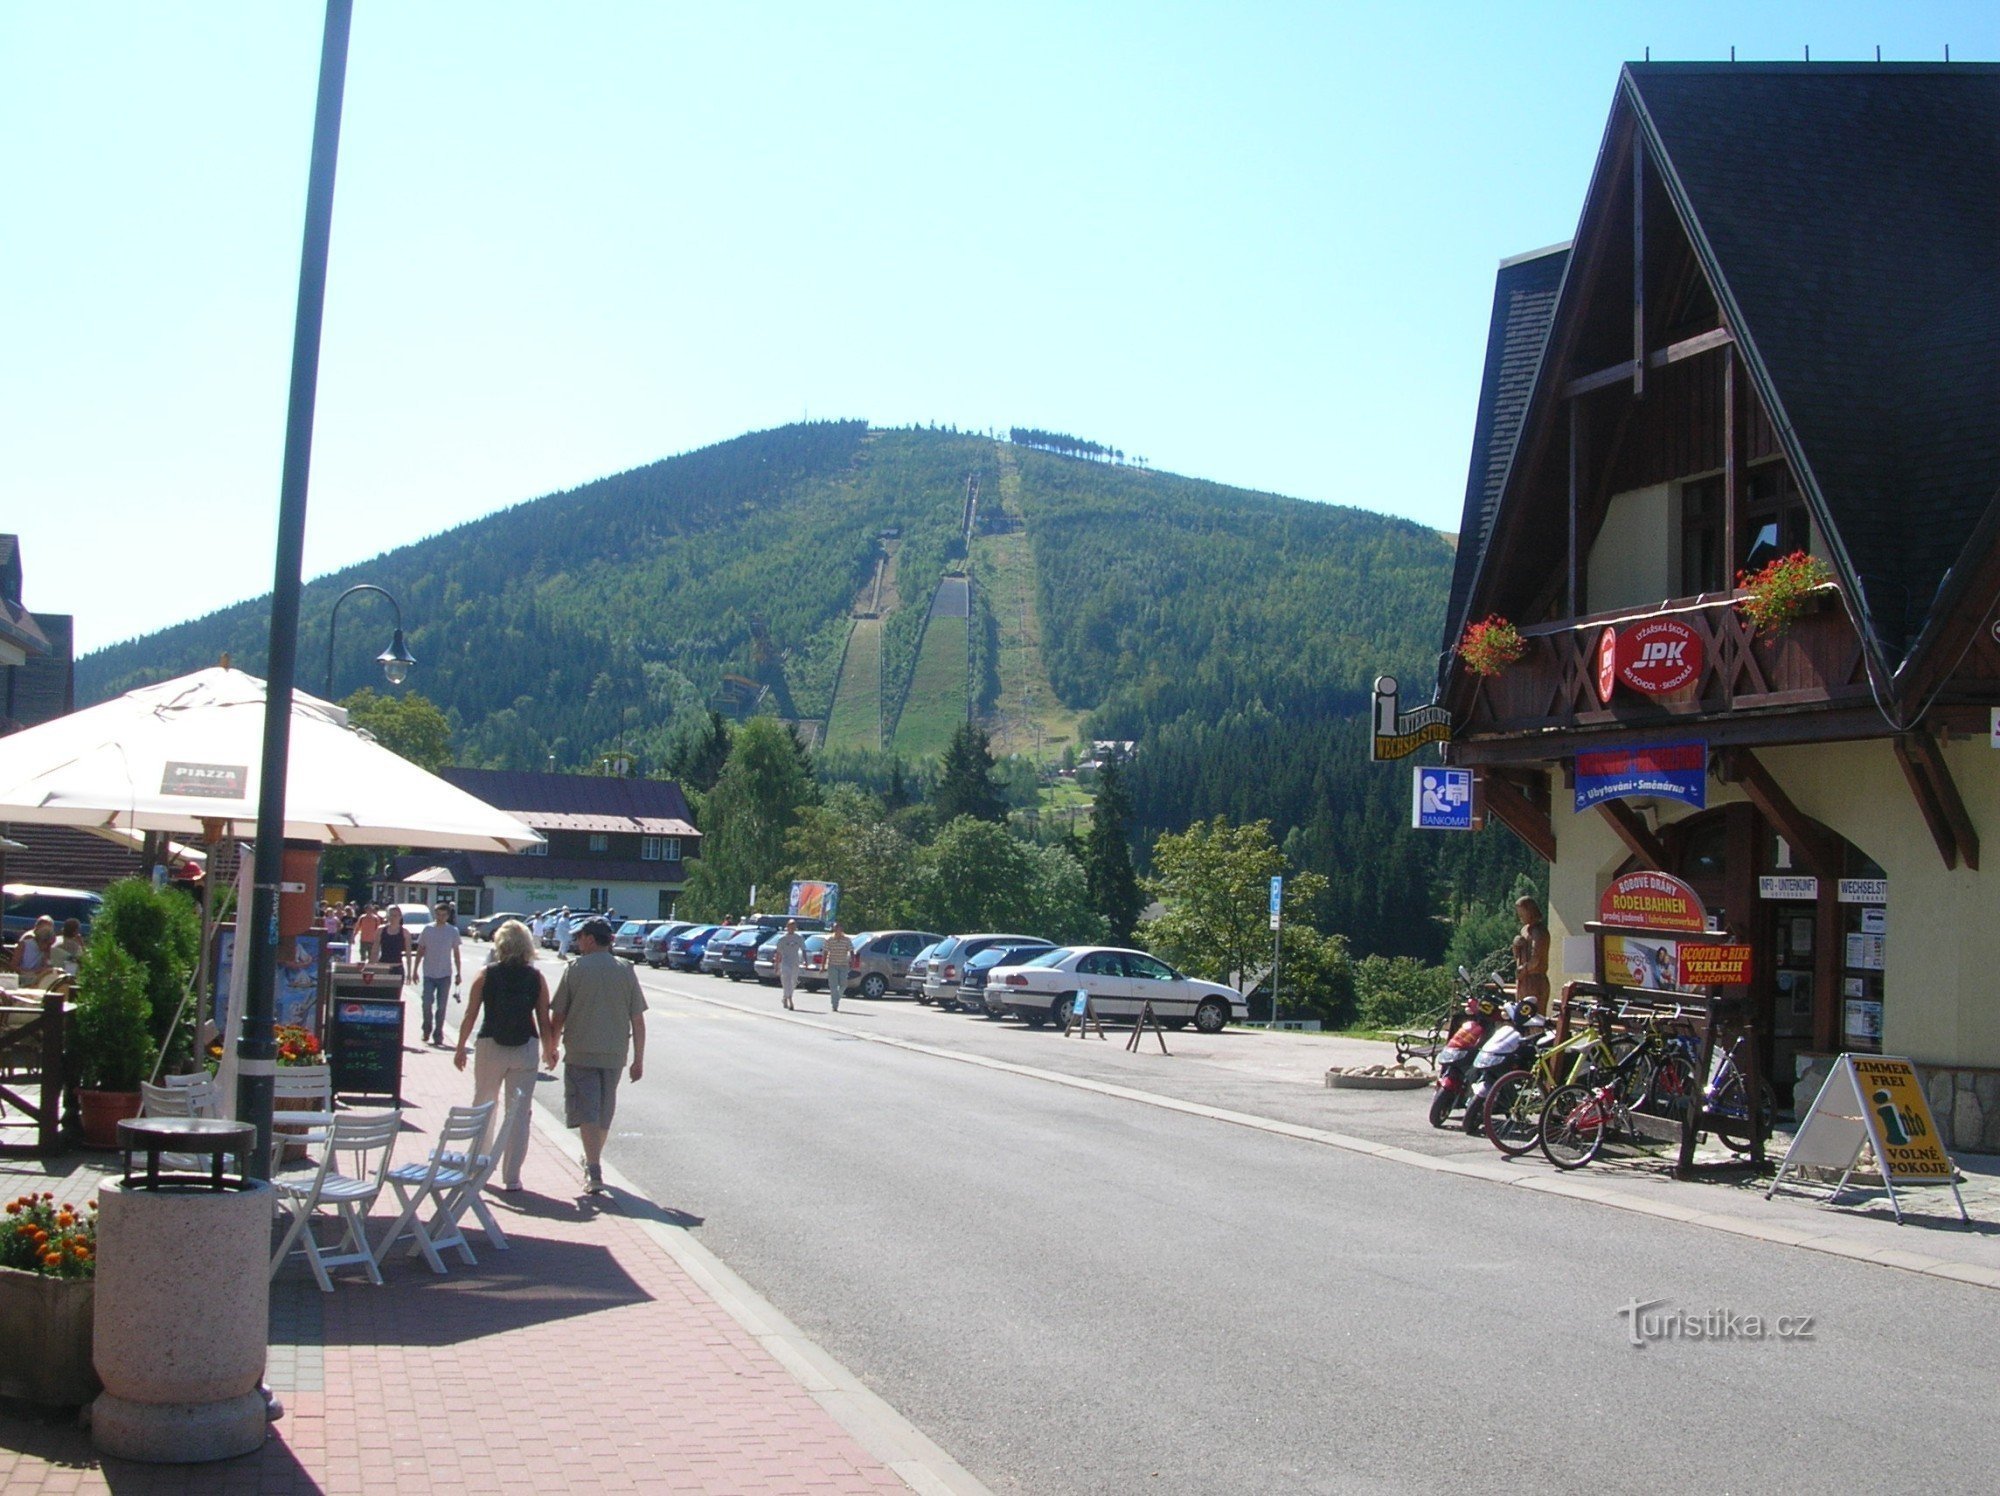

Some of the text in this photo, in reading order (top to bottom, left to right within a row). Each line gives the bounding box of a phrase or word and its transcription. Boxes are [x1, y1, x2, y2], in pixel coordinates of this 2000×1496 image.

[1668, 623, 1690, 639] ŠKOLA
[1632, 641, 1688, 669] JPK
[1623, 667, 1634, 680] SKI
[1633, 676, 1656, 690] SCHOOL
[1399, 706, 1451, 736] UNTERKUNFT
[175, 767, 237, 779] PIAZZA
[1587, 780, 1686, 799] Ubytování Směnárna
[1422, 815, 1469, 826] BANKOMAT
[1618, 875, 1677, 896] BOBOVÉ DRÁHY
[1613, 895, 1686, 913] RODELBAHNEN
[1681, 947, 1721, 960] SCOOTER
[1728, 948, 1750, 960] BIKE
[1687, 961, 1743, 972] VERLEIH
[1688, 972, 1742, 983] PŮJČOVNA
[363, 1009, 398, 1019] PEPSI
[1480, 1000, 1494, 1015] 3
[1520, 1004, 1532, 1015] 9
[1853, 1061, 1912, 1075] ZIMMER
[1871, 1075, 1906, 1087] FREI
[1872, 1088, 1927, 1146] info
[1887, 1146, 1940, 1160] VOLNÉ
[1887, 1162, 1949, 1174] POKOJE
